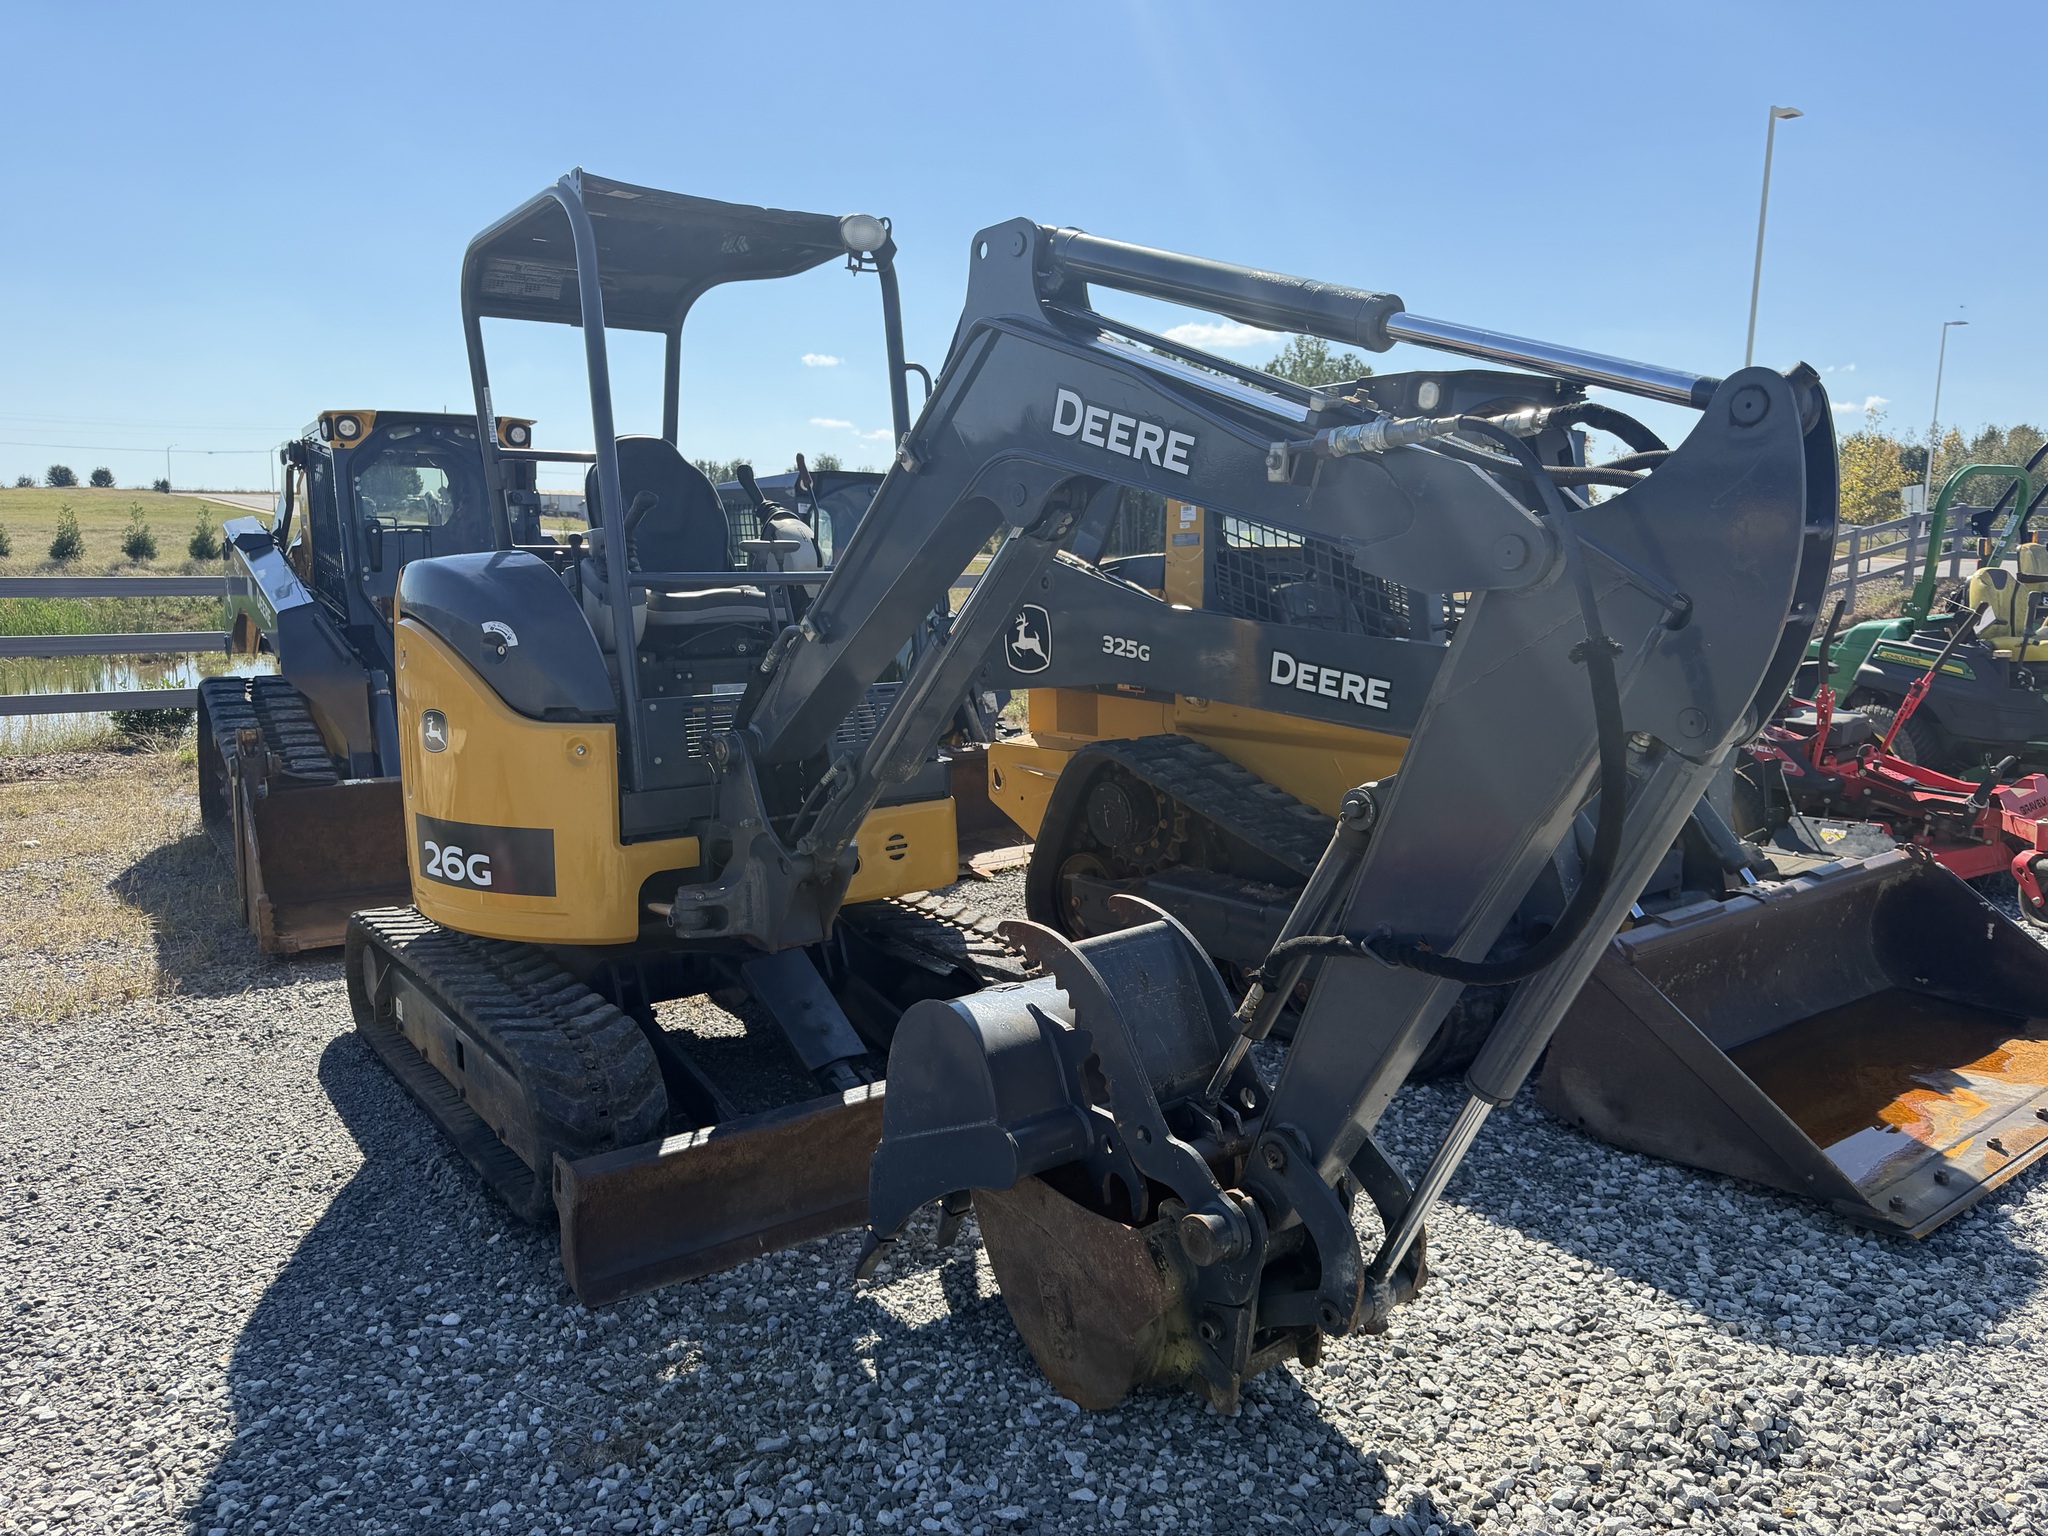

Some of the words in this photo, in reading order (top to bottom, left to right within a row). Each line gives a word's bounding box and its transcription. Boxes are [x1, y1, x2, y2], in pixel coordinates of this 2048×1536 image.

[1052, 388, 1195, 475] DEERE
[1102, 635, 1150, 662] 325G
[1271, 651, 1391, 710] DEERE
[2019, 796, 2047, 815] GRAVELY
[424, 840, 492, 886] 26G
